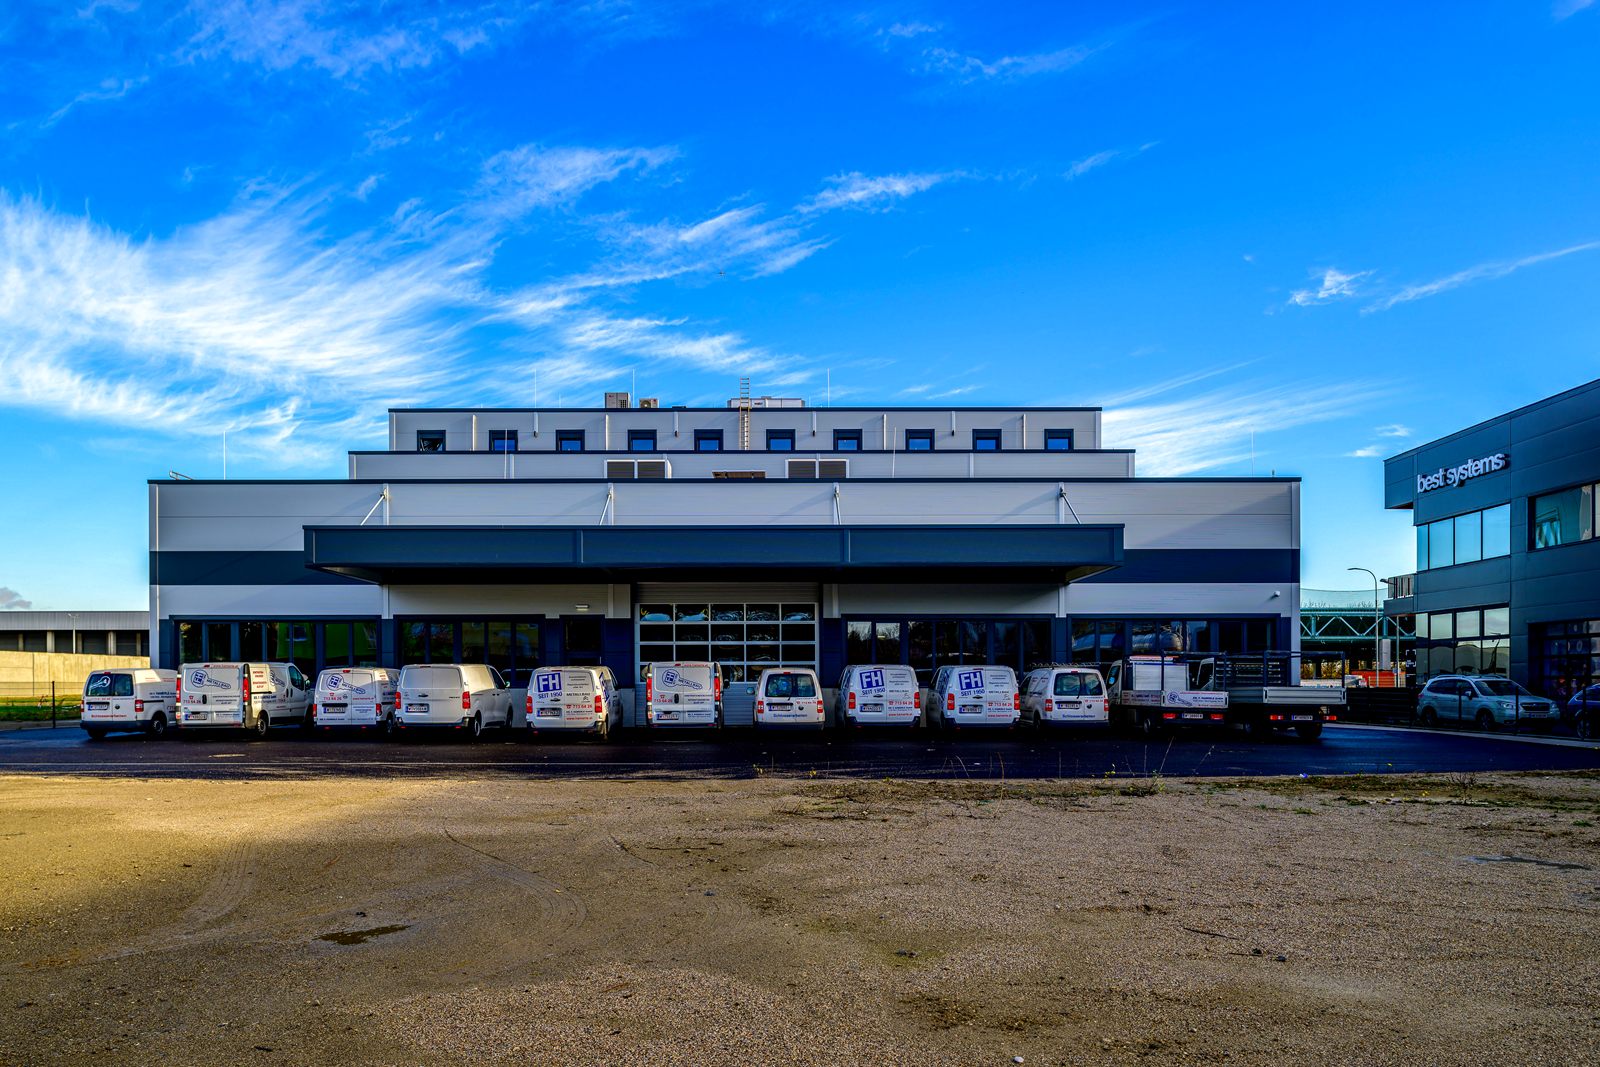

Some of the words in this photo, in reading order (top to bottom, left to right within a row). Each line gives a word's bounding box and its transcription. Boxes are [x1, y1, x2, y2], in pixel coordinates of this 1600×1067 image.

[1417, 468, 1444, 493] best
[1446, 453, 1506, 487] systems
[538, 673, 560, 691] FH
[861, 671, 883, 688] FH
[960, 672, 982, 689] FH
